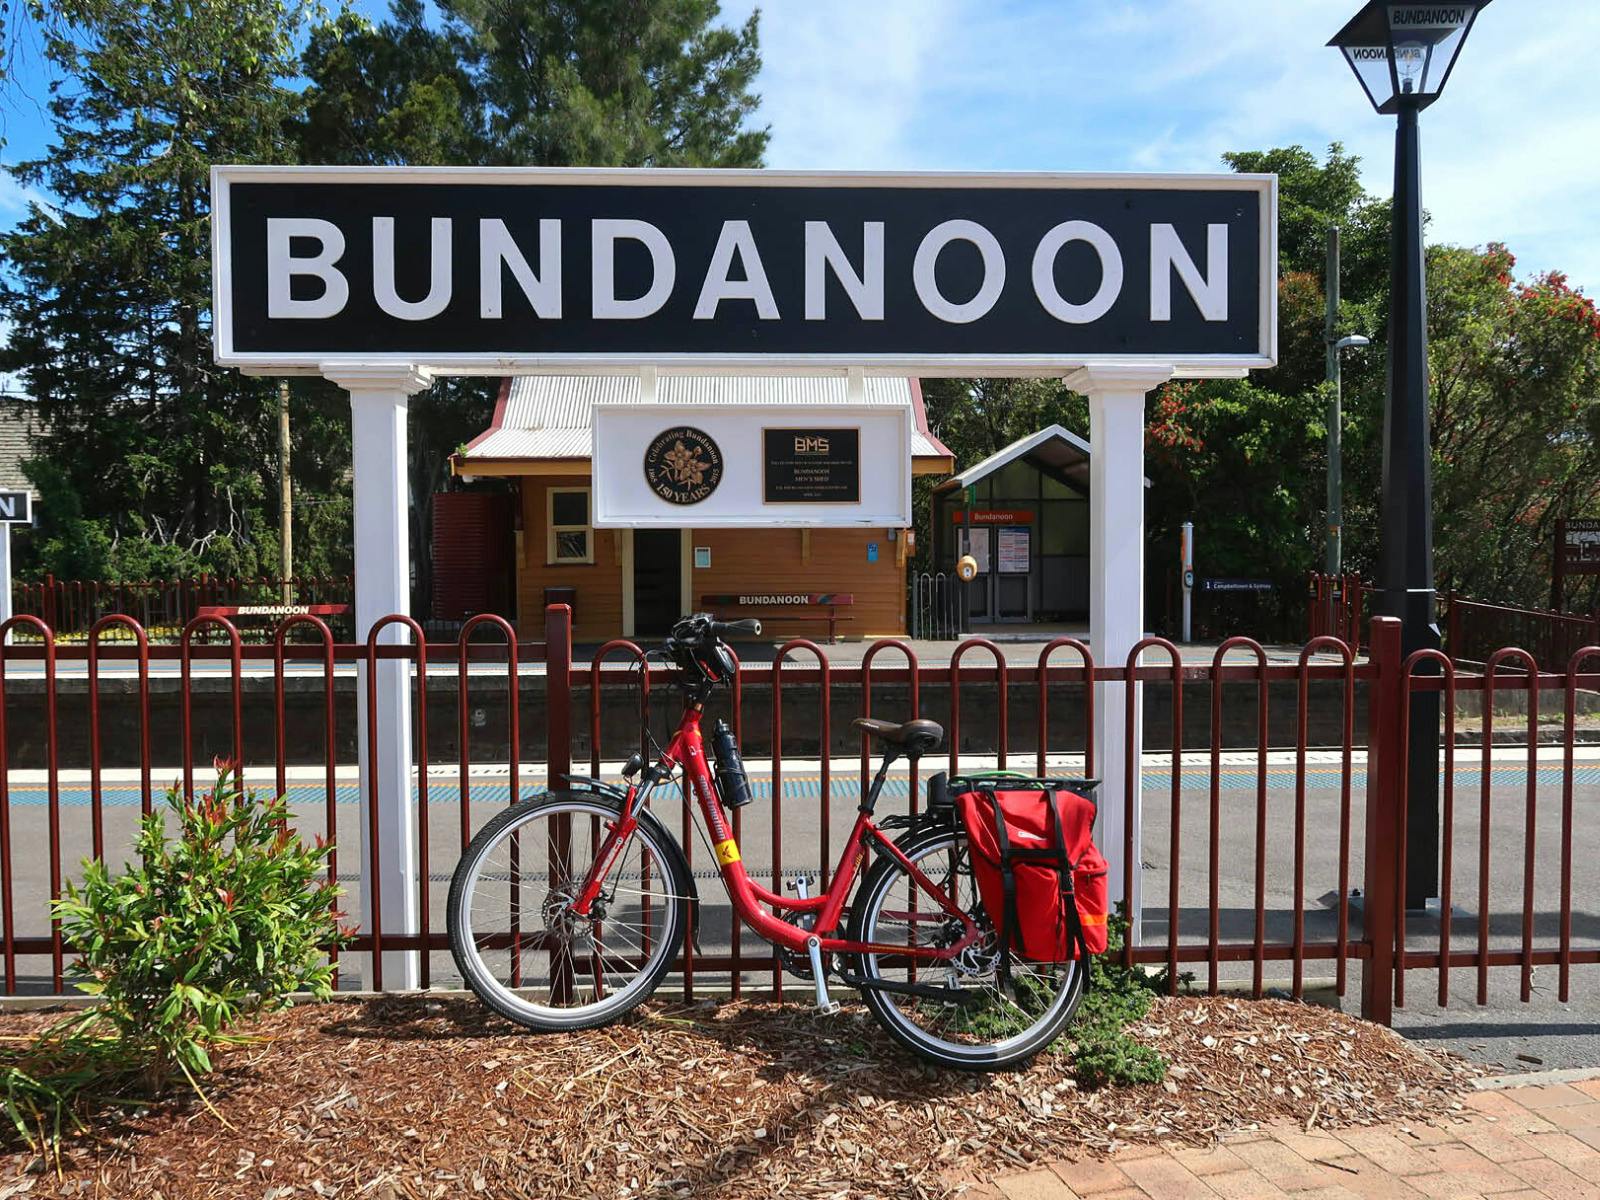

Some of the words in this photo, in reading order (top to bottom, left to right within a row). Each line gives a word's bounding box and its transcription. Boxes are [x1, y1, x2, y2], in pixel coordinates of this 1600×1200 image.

[1393, 8, 1465, 24] BUNDANOON
[266, 216, 1228, 325] BUNDANOON
[648, 431, 685, 463] Celebrating
[686, 429, 719, 464] Bundanoon
[795, 438, 829, 451] BMS
[656, 483, 673, 499] 150
[674, 484, 710, 503] YEARS
[974, 512, 1014, 520] Bundanoon
[739, 595, 809, 605] BUNDANOON
[237, 605, 310, 615] BUNDANOON
